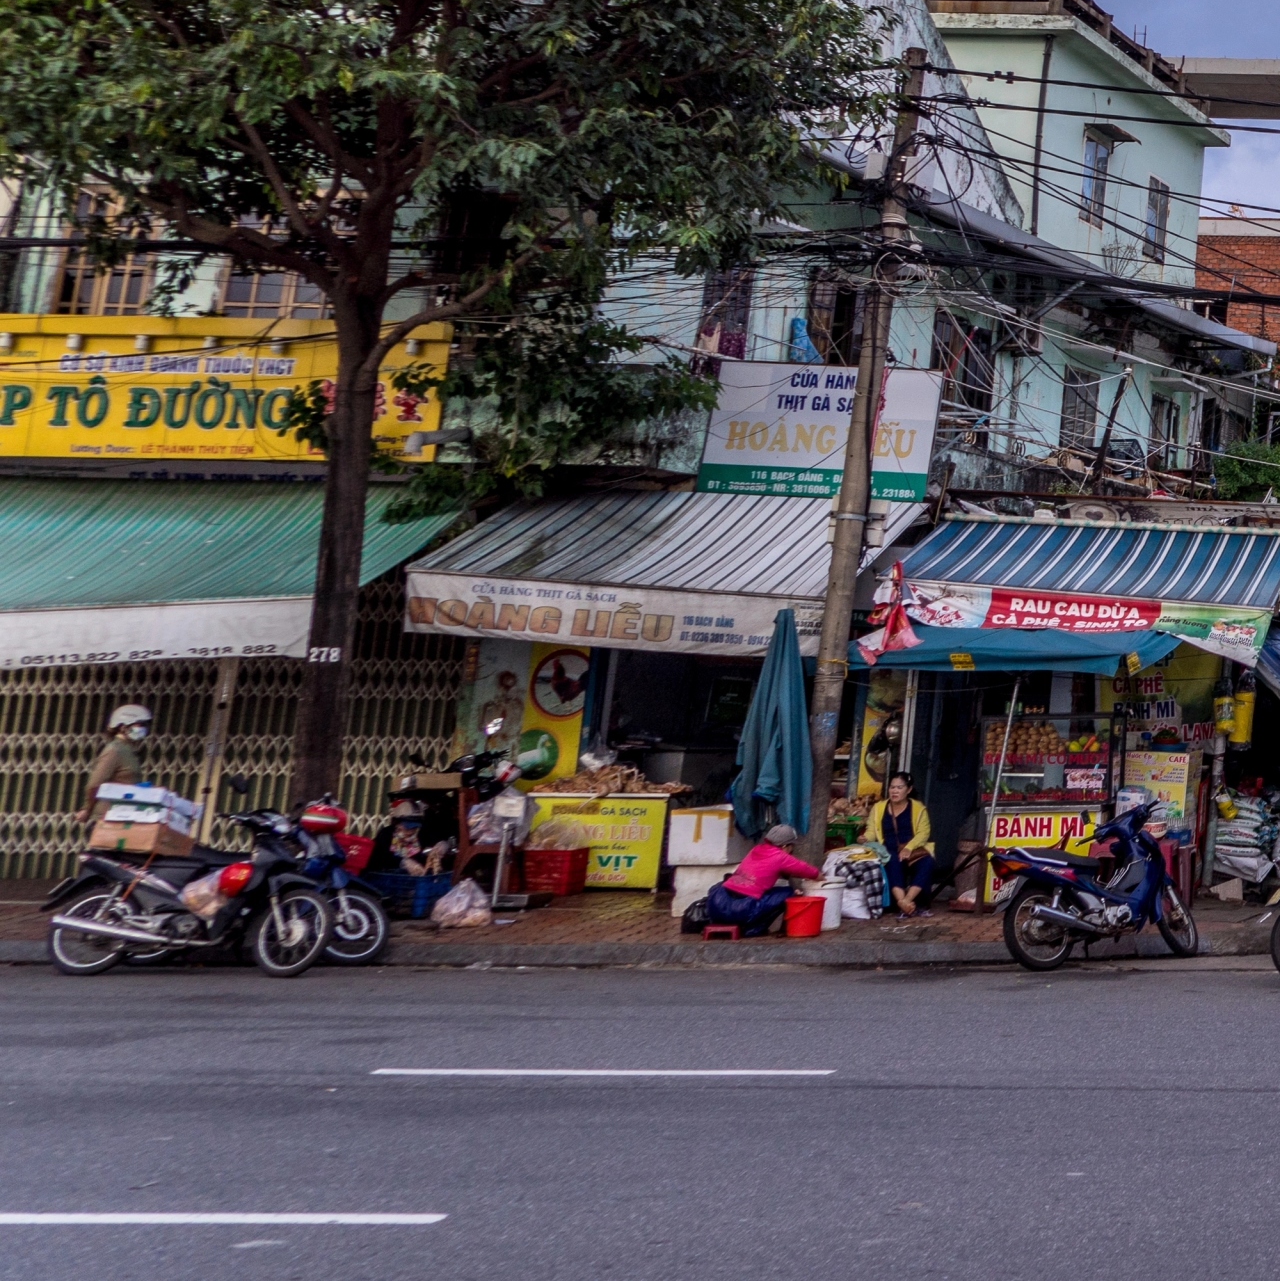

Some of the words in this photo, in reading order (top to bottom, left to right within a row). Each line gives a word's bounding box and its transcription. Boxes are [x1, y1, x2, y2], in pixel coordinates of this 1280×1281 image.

[790, 369, 818, 389] CỬA
[825, 369, 856, 390] HÀN
[46, 374, 110, 428] TÔ
[123, 376, 294, 430] ĐƯỜNG
[777, 394, 807, 412] THỊT
[812, 393, 831, 412] GÀ
[724, 417, 836, 455] HOÀNG
[751, 471, 767, 480] 116
[471, 581, 497, 595] CỬA
[499, 584, 532, 597] HÀNG
[536, 588, 564, 600] THỊT
[565, 589, 582, 601] GÀ
[585, 592, 618, 603] SẠCH
[408, 595, 563, 635] HOÀNG
[570, 601, 676, 643] LIỄU
[1010, 598, 1051, 614] RAU
[1054, 601, 1094, 618] CAU
[1103, 602, 1140, 619] DỪA
[991, 614, 1018, 625] CÀ
[1021, 616, 1061, 628] PHÊ
[1073, 619, 1119, 629] SINH
[309, 647, 341, 663] 278
[1112, 672, 1132, 694] CÀ
[1135, 671, 1164, 694] PHÊ
[1157, 697, 1176, 719] MÌ
[619, 806, 648, 817] SẠCH
[609, 818, 653, 841] LIỄU
[995, 813, 1053, 838] BÁNH
[596, 854, 638, 871] VỊT
